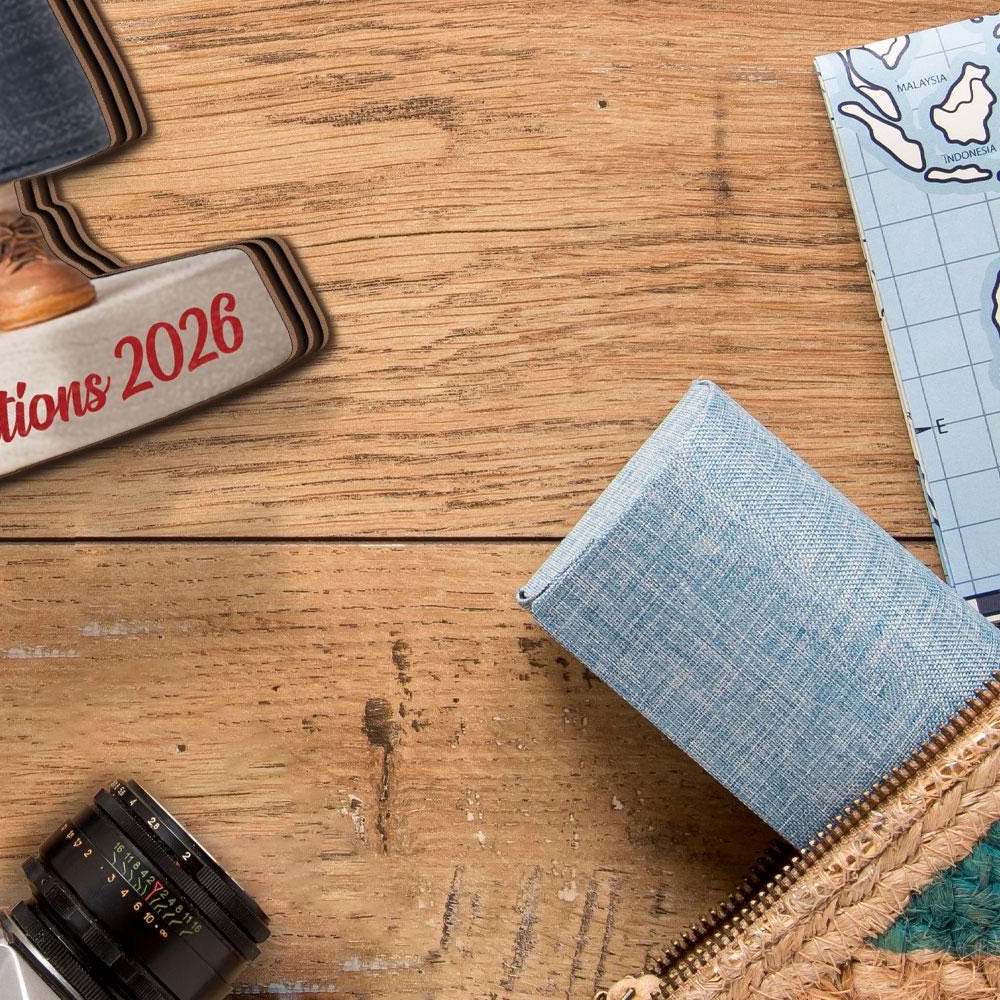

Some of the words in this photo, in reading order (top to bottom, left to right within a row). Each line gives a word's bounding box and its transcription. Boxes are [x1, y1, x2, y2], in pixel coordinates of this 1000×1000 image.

[896, 73, 947, 93] MALAYSIA
[943, 144, 997, 164] INDONESIA
[113, 292, 244, 400] 2026
[936, 418, 948, 434] E
[182, 851, 191, 861] 2
[83, 849, 92, 858] 2
[120, 889, 130, 898] 4
[133, 901, 142, 911] 6
[143, 911, 155, 924] 10
[113, 842, 125, 853] 16
[124, 852, 134, 863] 11
[133, 861, 141, 870] 8
[140, 870, 149, 878] 4
[146, 876, 156, 885] 2
[160, 889, 169, 899] 2
[168, 898, 176, 907] 4
[175, 904, 184, 914] 8
[182, 912, 193, 924] 11
[191, 921, 202, 933] 16
